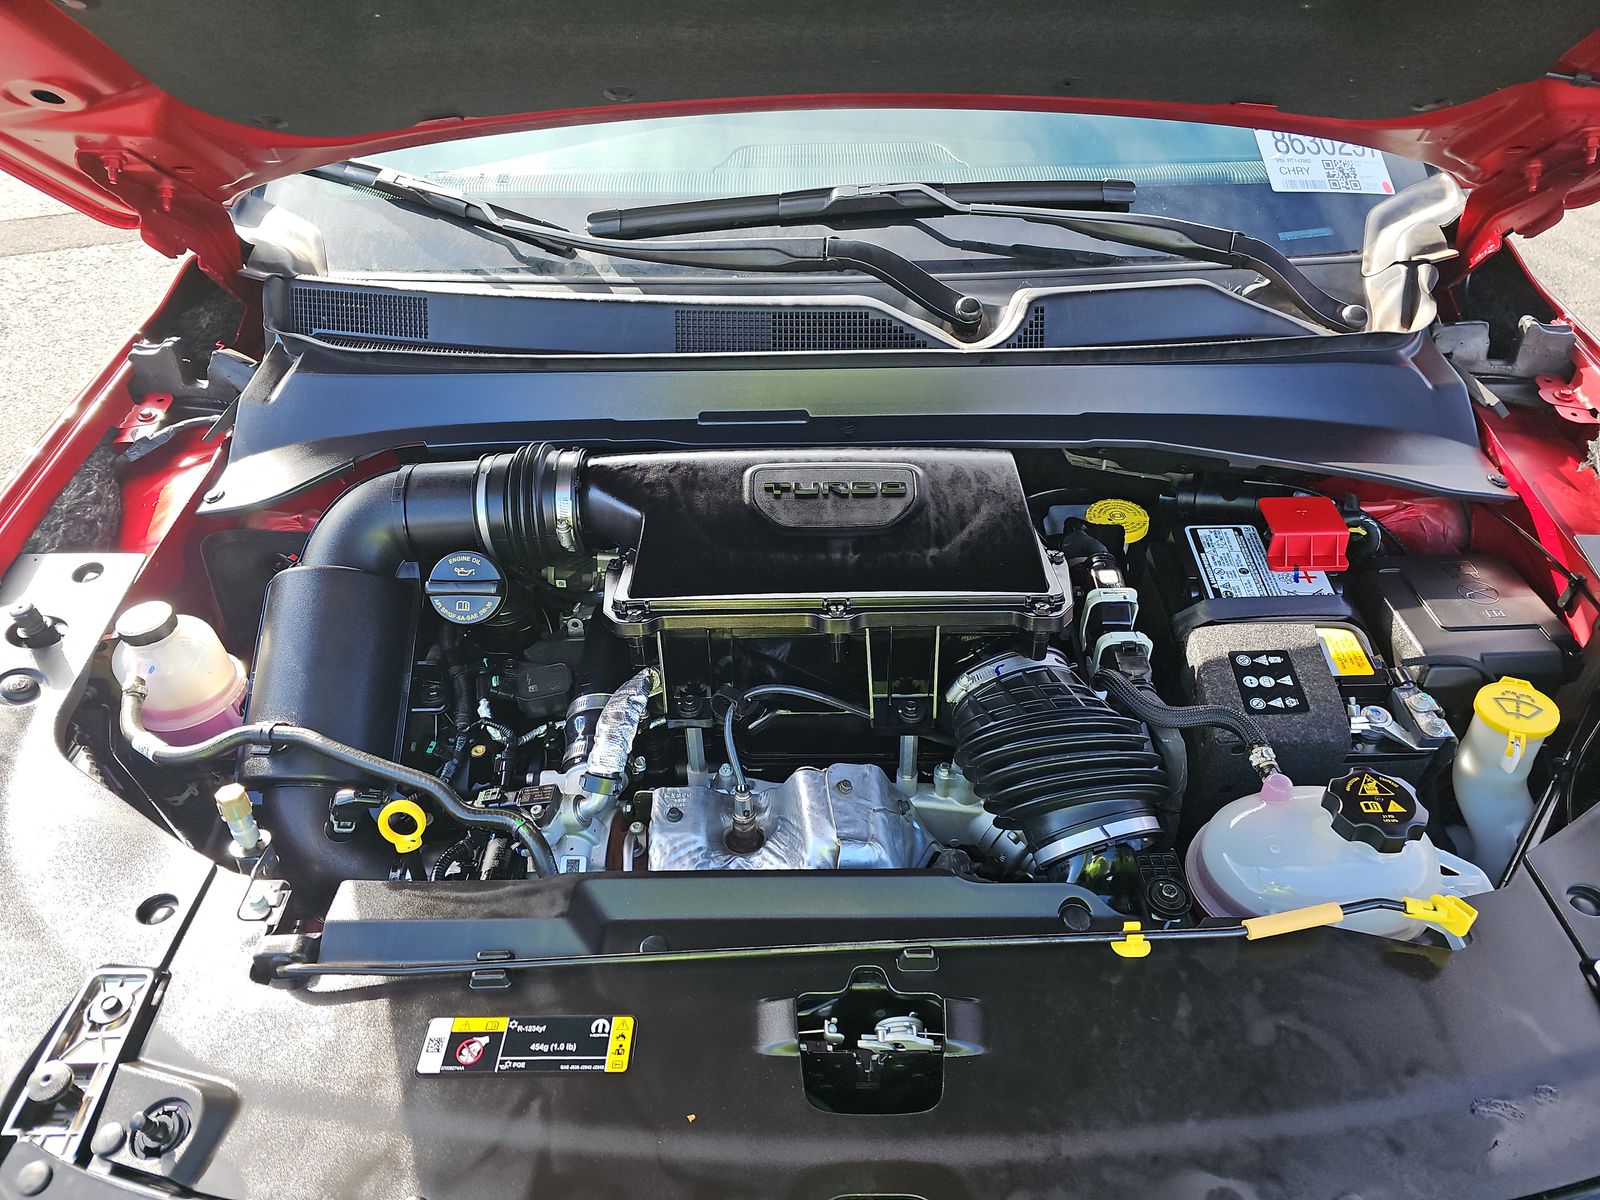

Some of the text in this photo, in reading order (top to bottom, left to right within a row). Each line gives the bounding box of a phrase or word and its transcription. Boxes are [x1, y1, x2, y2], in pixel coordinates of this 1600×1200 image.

[1271, 131, 1376, 158] 86302
[1279, 166, 1310, 176] CHRY
[763, 481, 908, 499] TURBO
[448, 556, 481, 566] ENGINE OIL
[516, 1025, 547, 1034] R-1234yf
[529, 1043, 577, 1053] 454g (1.0 lb)
